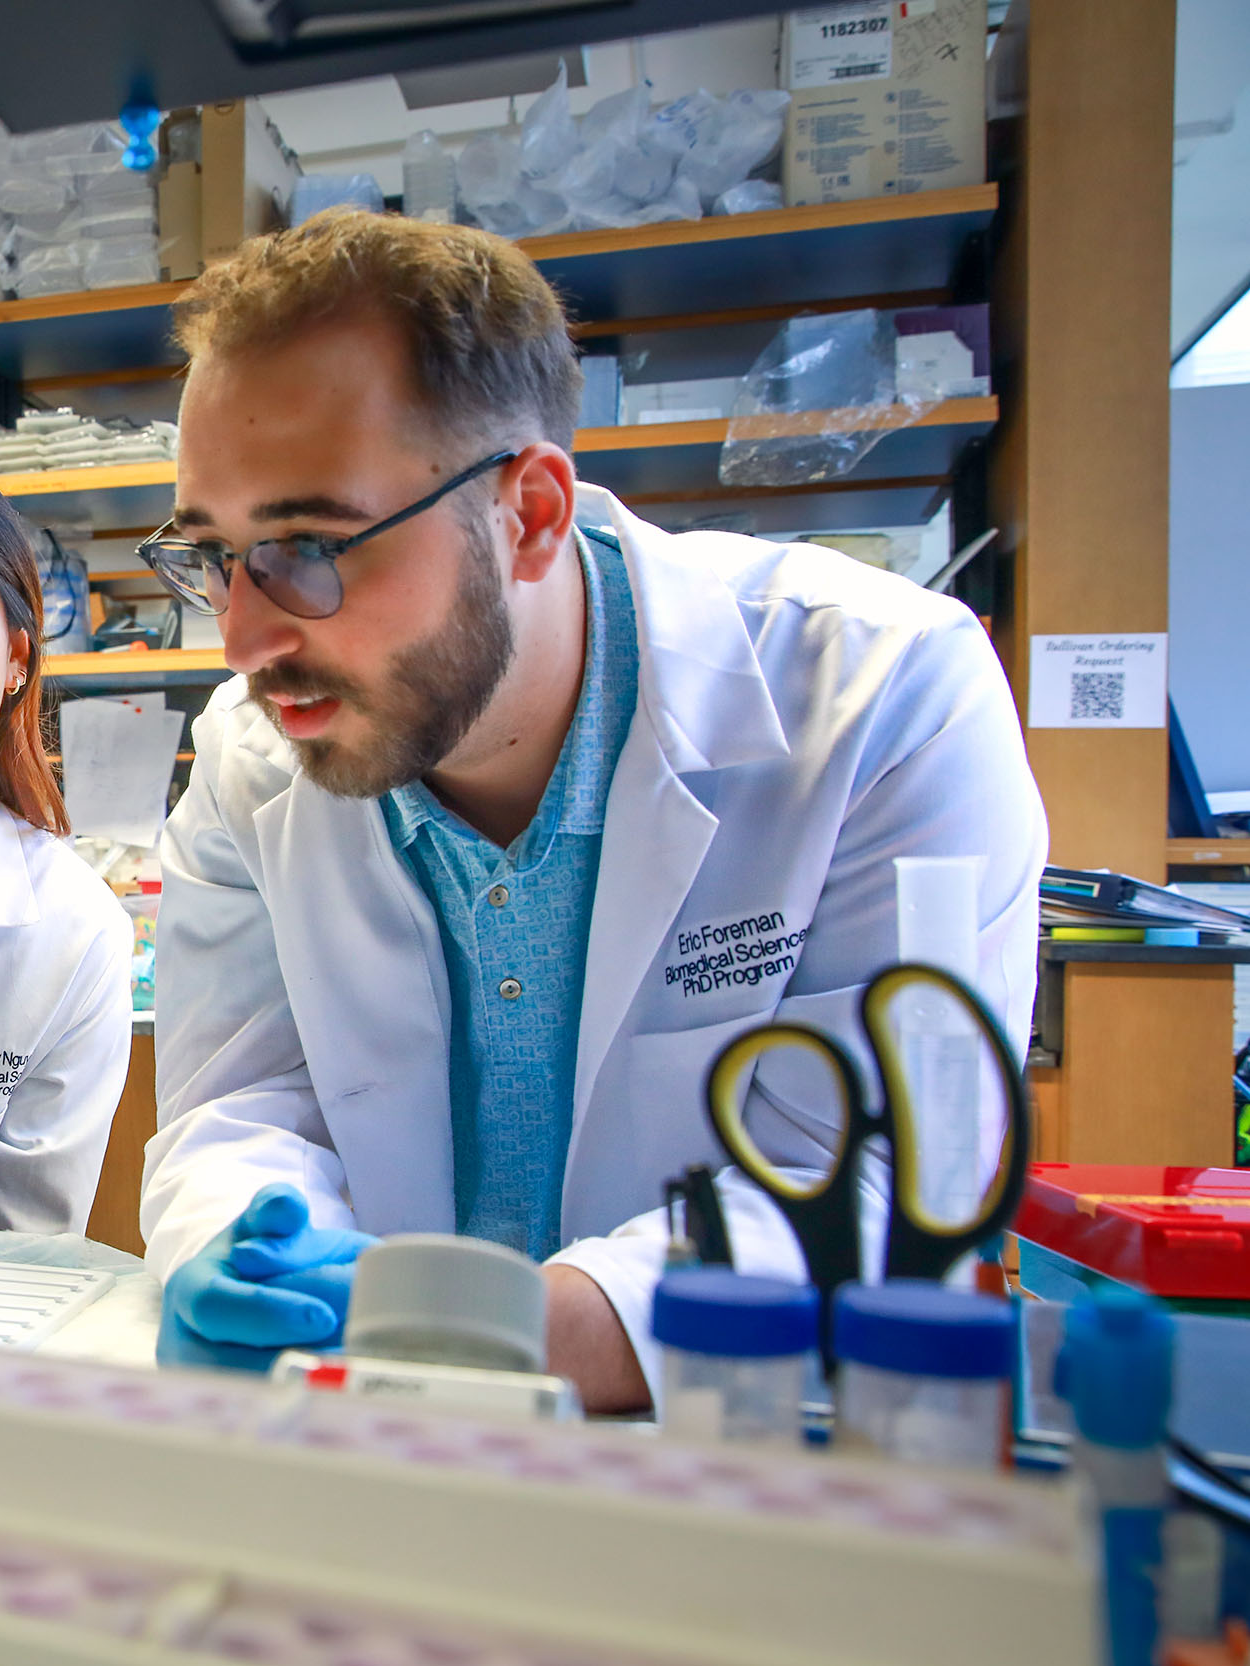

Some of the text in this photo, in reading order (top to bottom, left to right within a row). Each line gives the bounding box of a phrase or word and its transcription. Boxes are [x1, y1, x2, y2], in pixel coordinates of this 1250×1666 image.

[821, 16, 888, 38] 1182307
[1074, 655, 1124, 668] Request
[1098, 640, 1155, 653] Ordering
[678, 911, 785, 955] Eric Foreman
[665, 947, 735, 985] Biomedical
[683, 955, 794, 998] PhD Program
